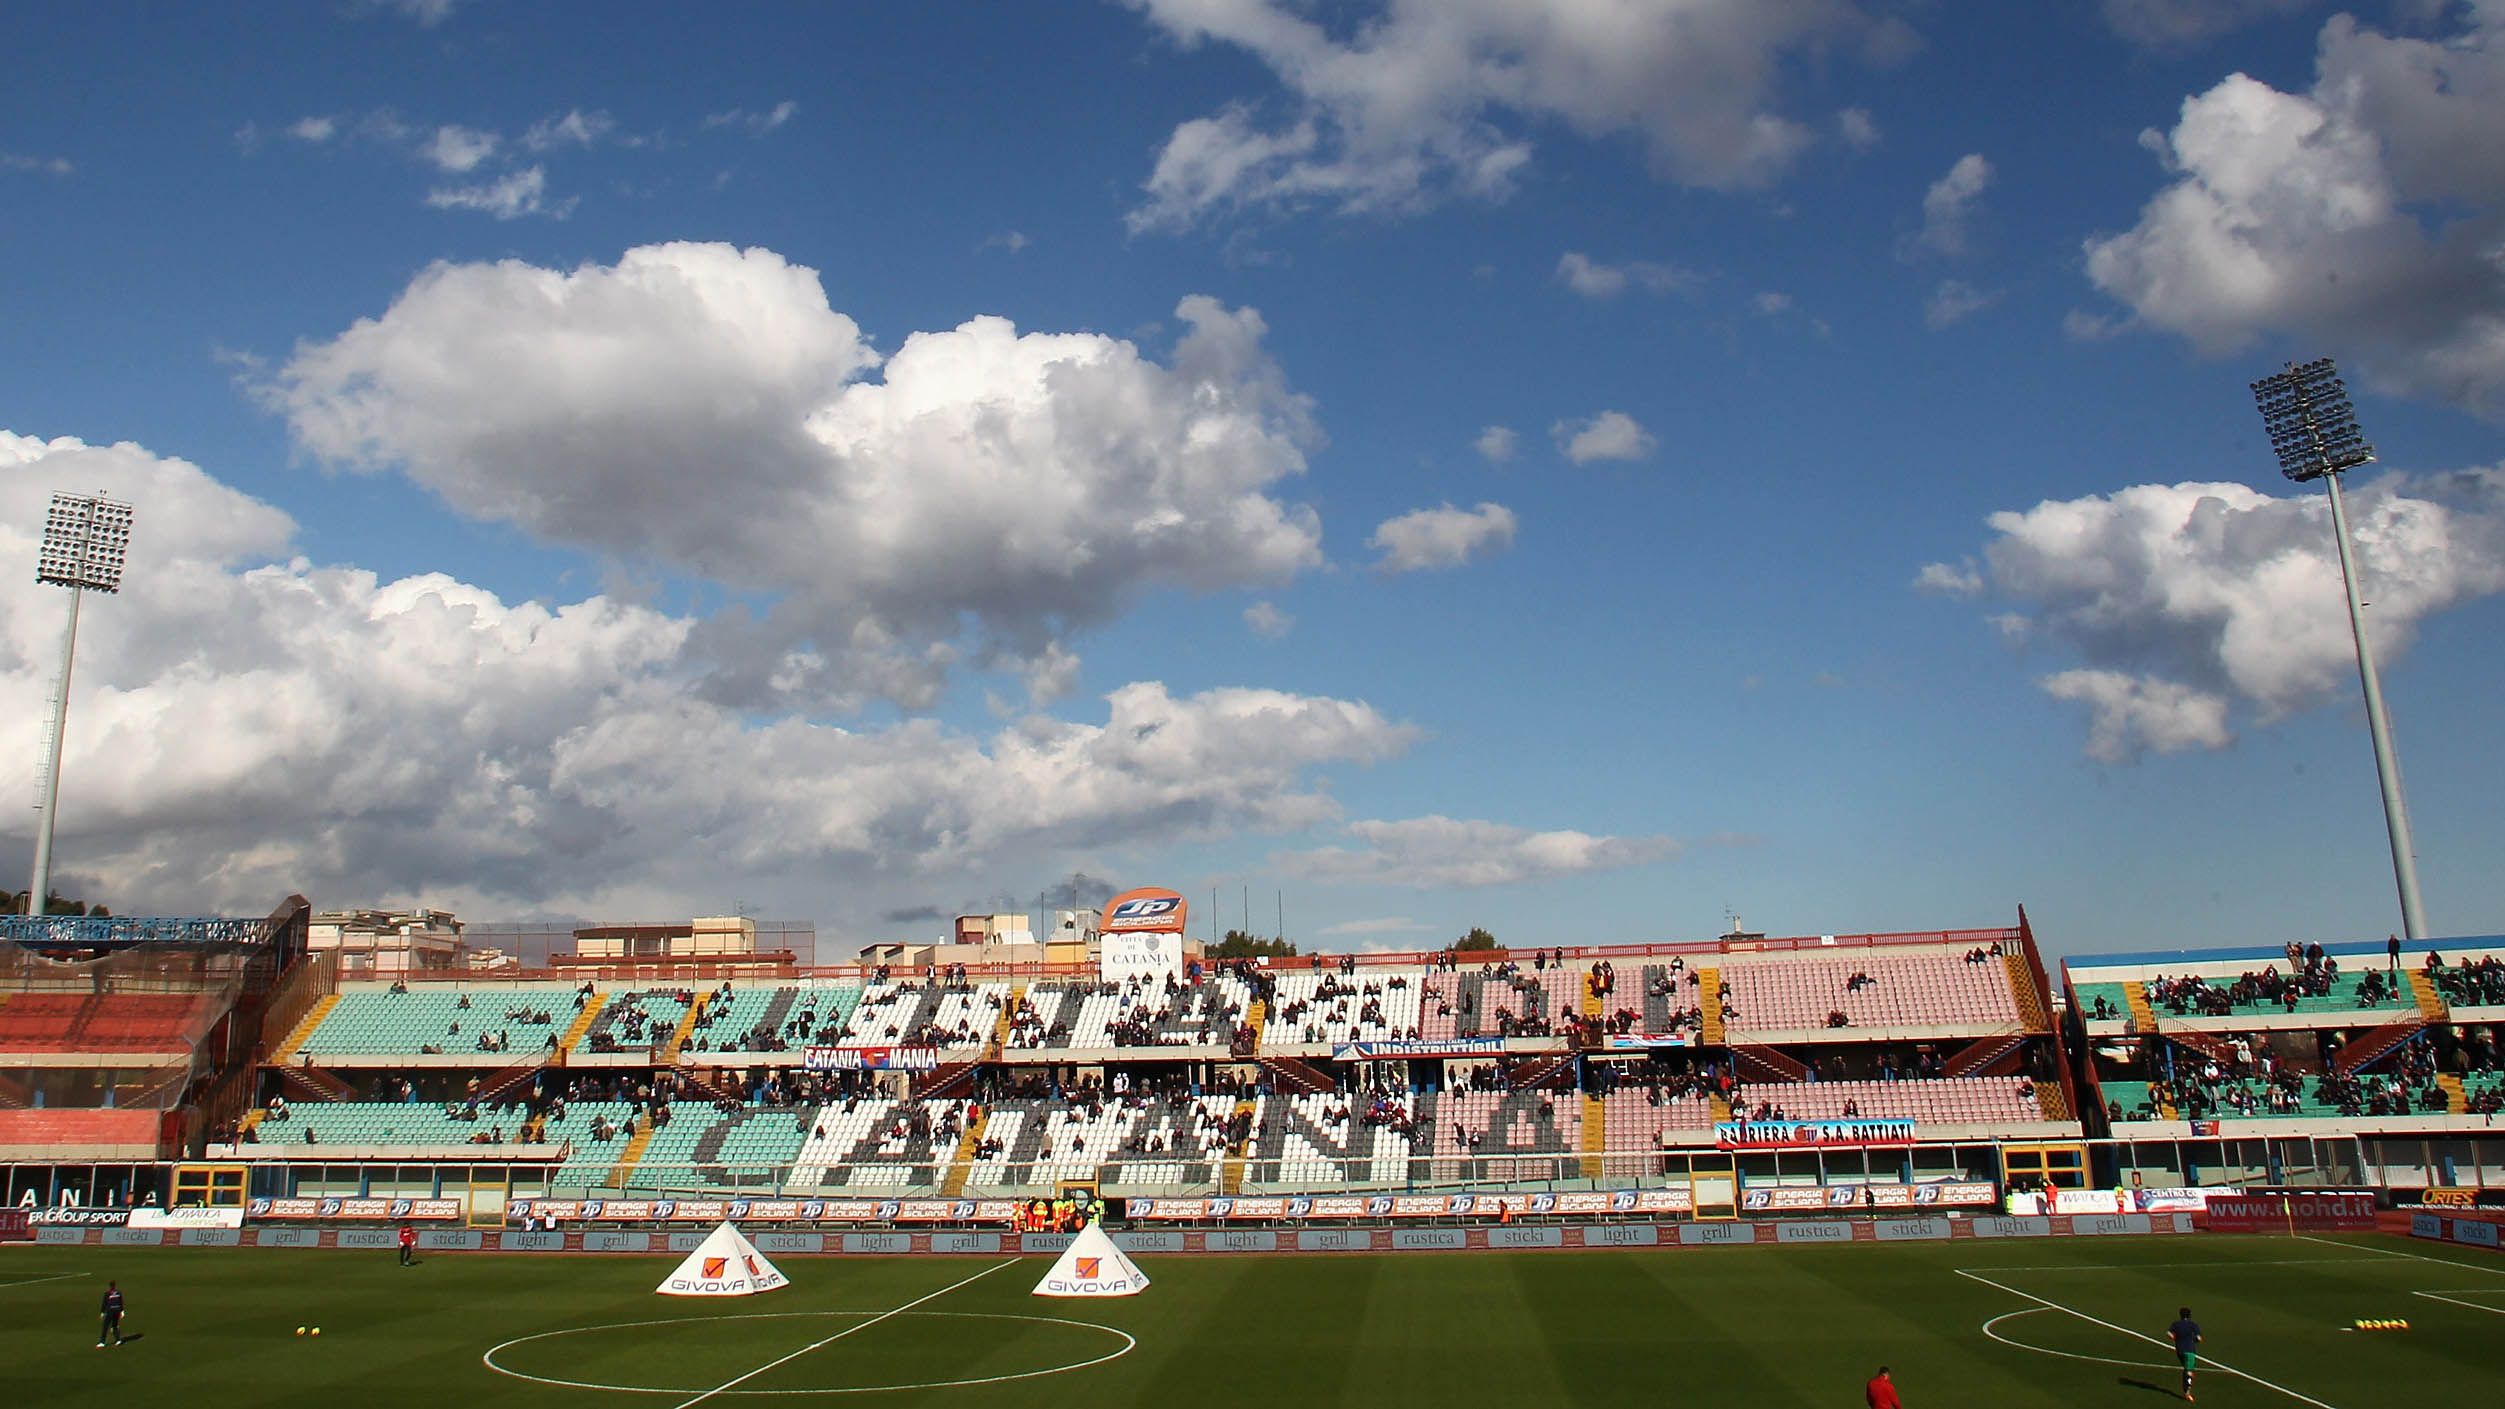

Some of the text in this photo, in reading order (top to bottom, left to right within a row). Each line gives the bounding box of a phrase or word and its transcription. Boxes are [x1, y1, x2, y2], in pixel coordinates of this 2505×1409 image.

[1112, 954, 1171, 963] CATANIA
[1371, 1040, 1505, 1056] INDISTRUTTIBILI
[805, 1049, 937, 1069] CATANIA MANIA
[1821, 1125, 1848, 1142] S.A.
[1852, 1123, 1912, 1141] BATTIATI
[1641, 1192, 1691, 1200] ENERGIA
[1774, 1190, 1823, 1198] ENERGIA
[1942, 1186, 1992, 1194] ENERGIA
[2421, 1187, 2478, 1205] ORTES
[274, 1200, 316, 1208] ENERGIA
[344, 1200, 386, 1208] ENERGIA
[903, 1201, 947, 1210] ENERGIA
[1157, 1200, 1202, 1208] ENERGIA
[1236, 1199, 1282, 1207] ENERGIA
[1397, 1196, 1444, 1205] ENERGIA
[1560, 1195, 1607, 1203] ENERGIA
[679, 1202, 722, 1210] ENERGIA
[752, 1202, 796, 1210] ENERGIA
[827, 1202, 871, 1210] ENERGIA
[47, 1211, 92, 1223] GROUP
[90, 1212, 129, 1223] SPORT
[1788, 1223, 1841, 1237] rustica
[1891, 1220, 1933, 1236] sticki
[1994, 1216, 2030, 1236] light
[2095, 1215, 2127, 1235] grill
[38, 1230, 74, 1240] ustica
[115, 1230, 148, 1241] sticki
[195, 1229, 226, 1242] light
[275, 1230, 301, 1244] grill
[347, 1231, 390, 1244] rustica
[432, 1231, 466, 1245] sticki
[517, 1231, 549, 1248] light
[1404, 1230, 1455, 1245] rustica
[1504, 1228, 1545, 1243] sticki
[1603, 1225, 1639, 1244] light
[1702, 1223, 1731, 1243] grill
[603, 1233, 629, 1249] grill
[770, 1234, 807, 1248] sticki
[861, 1233, 894, 1250] light
[951, 1234, 980, 1251] grill
[1031, 1235, 1072, 1248] rustic
[1128, 1233, 1168, 1248] sticki
[1223, 1232, 1258, 1249] light
[1319, 1232, 1348, 1250] grill
[671, 1279, 745, 1292] GIVOVA
[1047, 1279, 1128, 1292] GIVOVA
